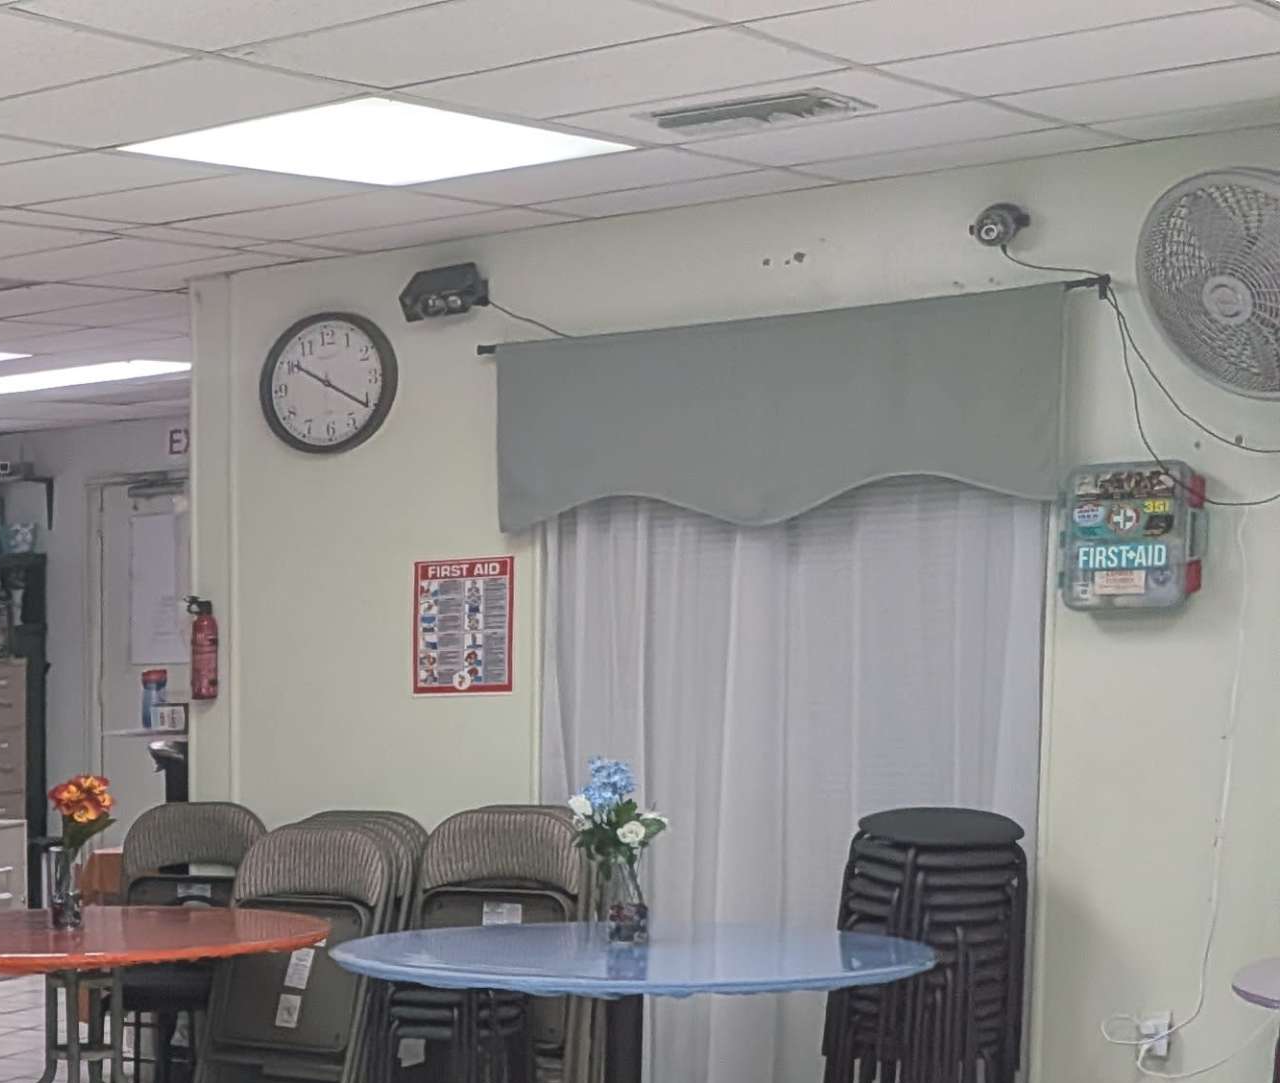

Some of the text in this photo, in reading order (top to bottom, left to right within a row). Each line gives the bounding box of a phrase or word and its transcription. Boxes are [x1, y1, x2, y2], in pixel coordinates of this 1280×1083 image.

[321, 329, 336, 346] 12
[301, 340, 313, 357] 11
[359, 345, 369, 361] 2
[368, 368, 378, 384] 3
[278, 383, 288, 398] 9
[304, 418, 313, 435] 7
[326, 420, 336, 436] 6
[1078, 544, 1167, 569] FIRST AID
[428, 562, 500, 579] FIRST AID
